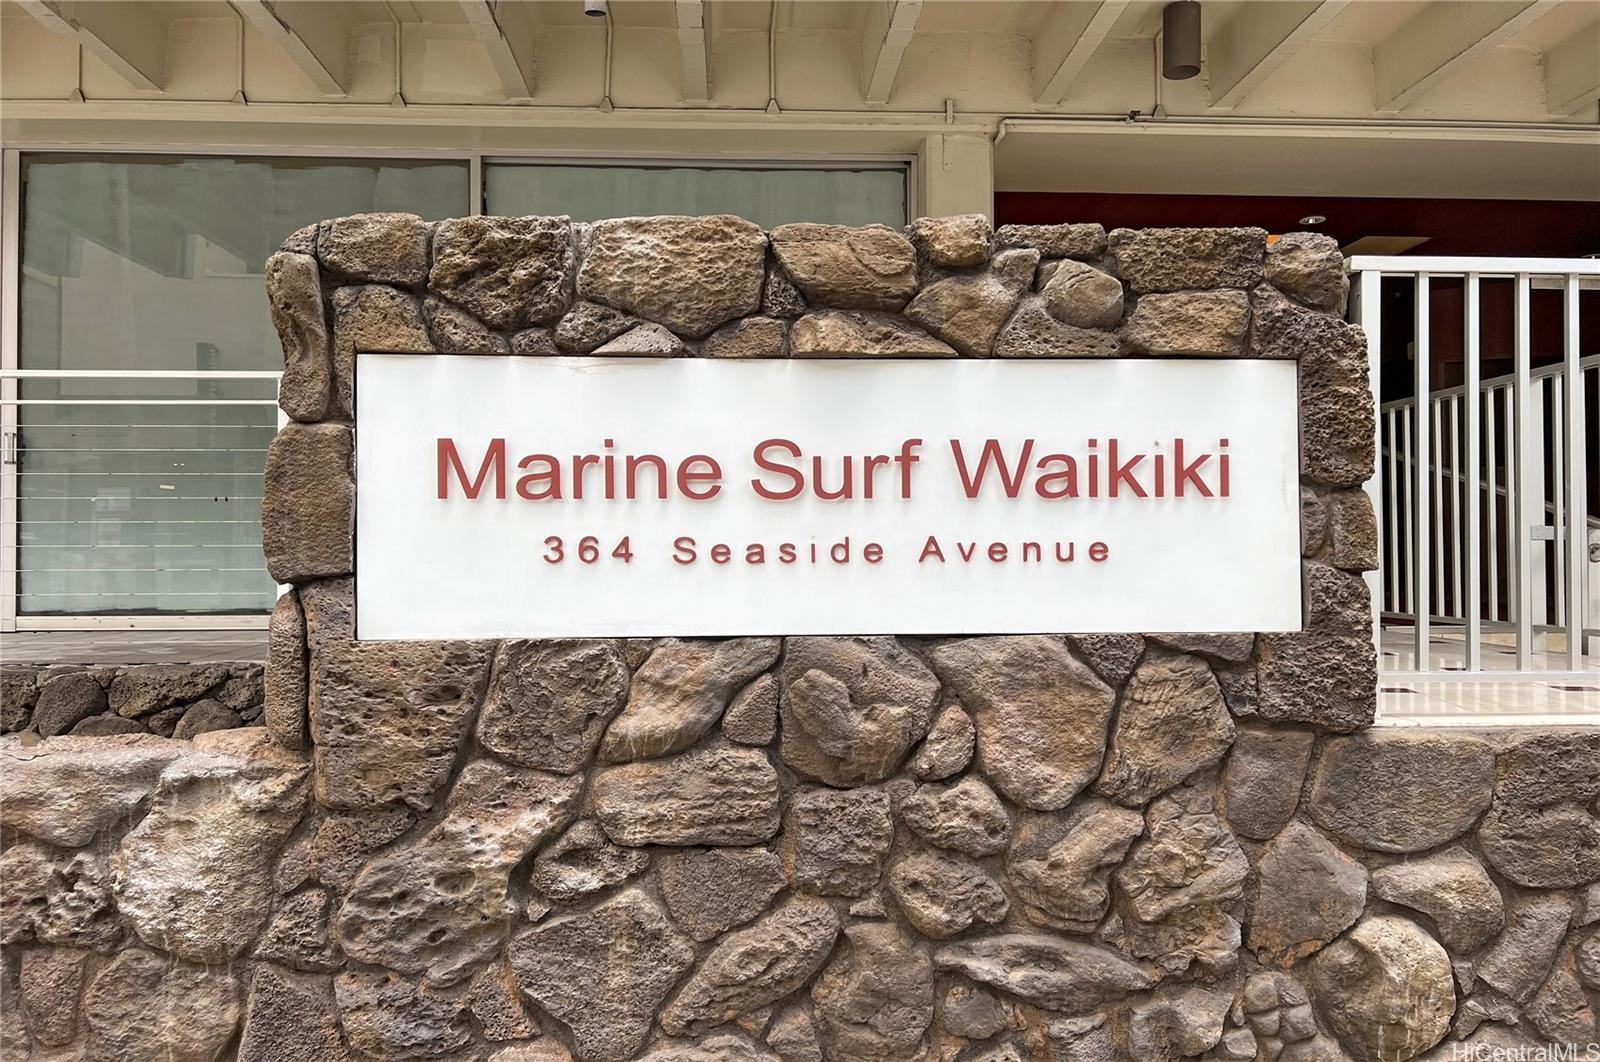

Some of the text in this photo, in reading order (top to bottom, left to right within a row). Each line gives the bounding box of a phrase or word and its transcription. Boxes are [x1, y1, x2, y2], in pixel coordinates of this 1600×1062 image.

[437, 437, 1230, 501] Marine Surf Waikiki
[544, 536, 1108, 564] 364 Seaside Avenue
